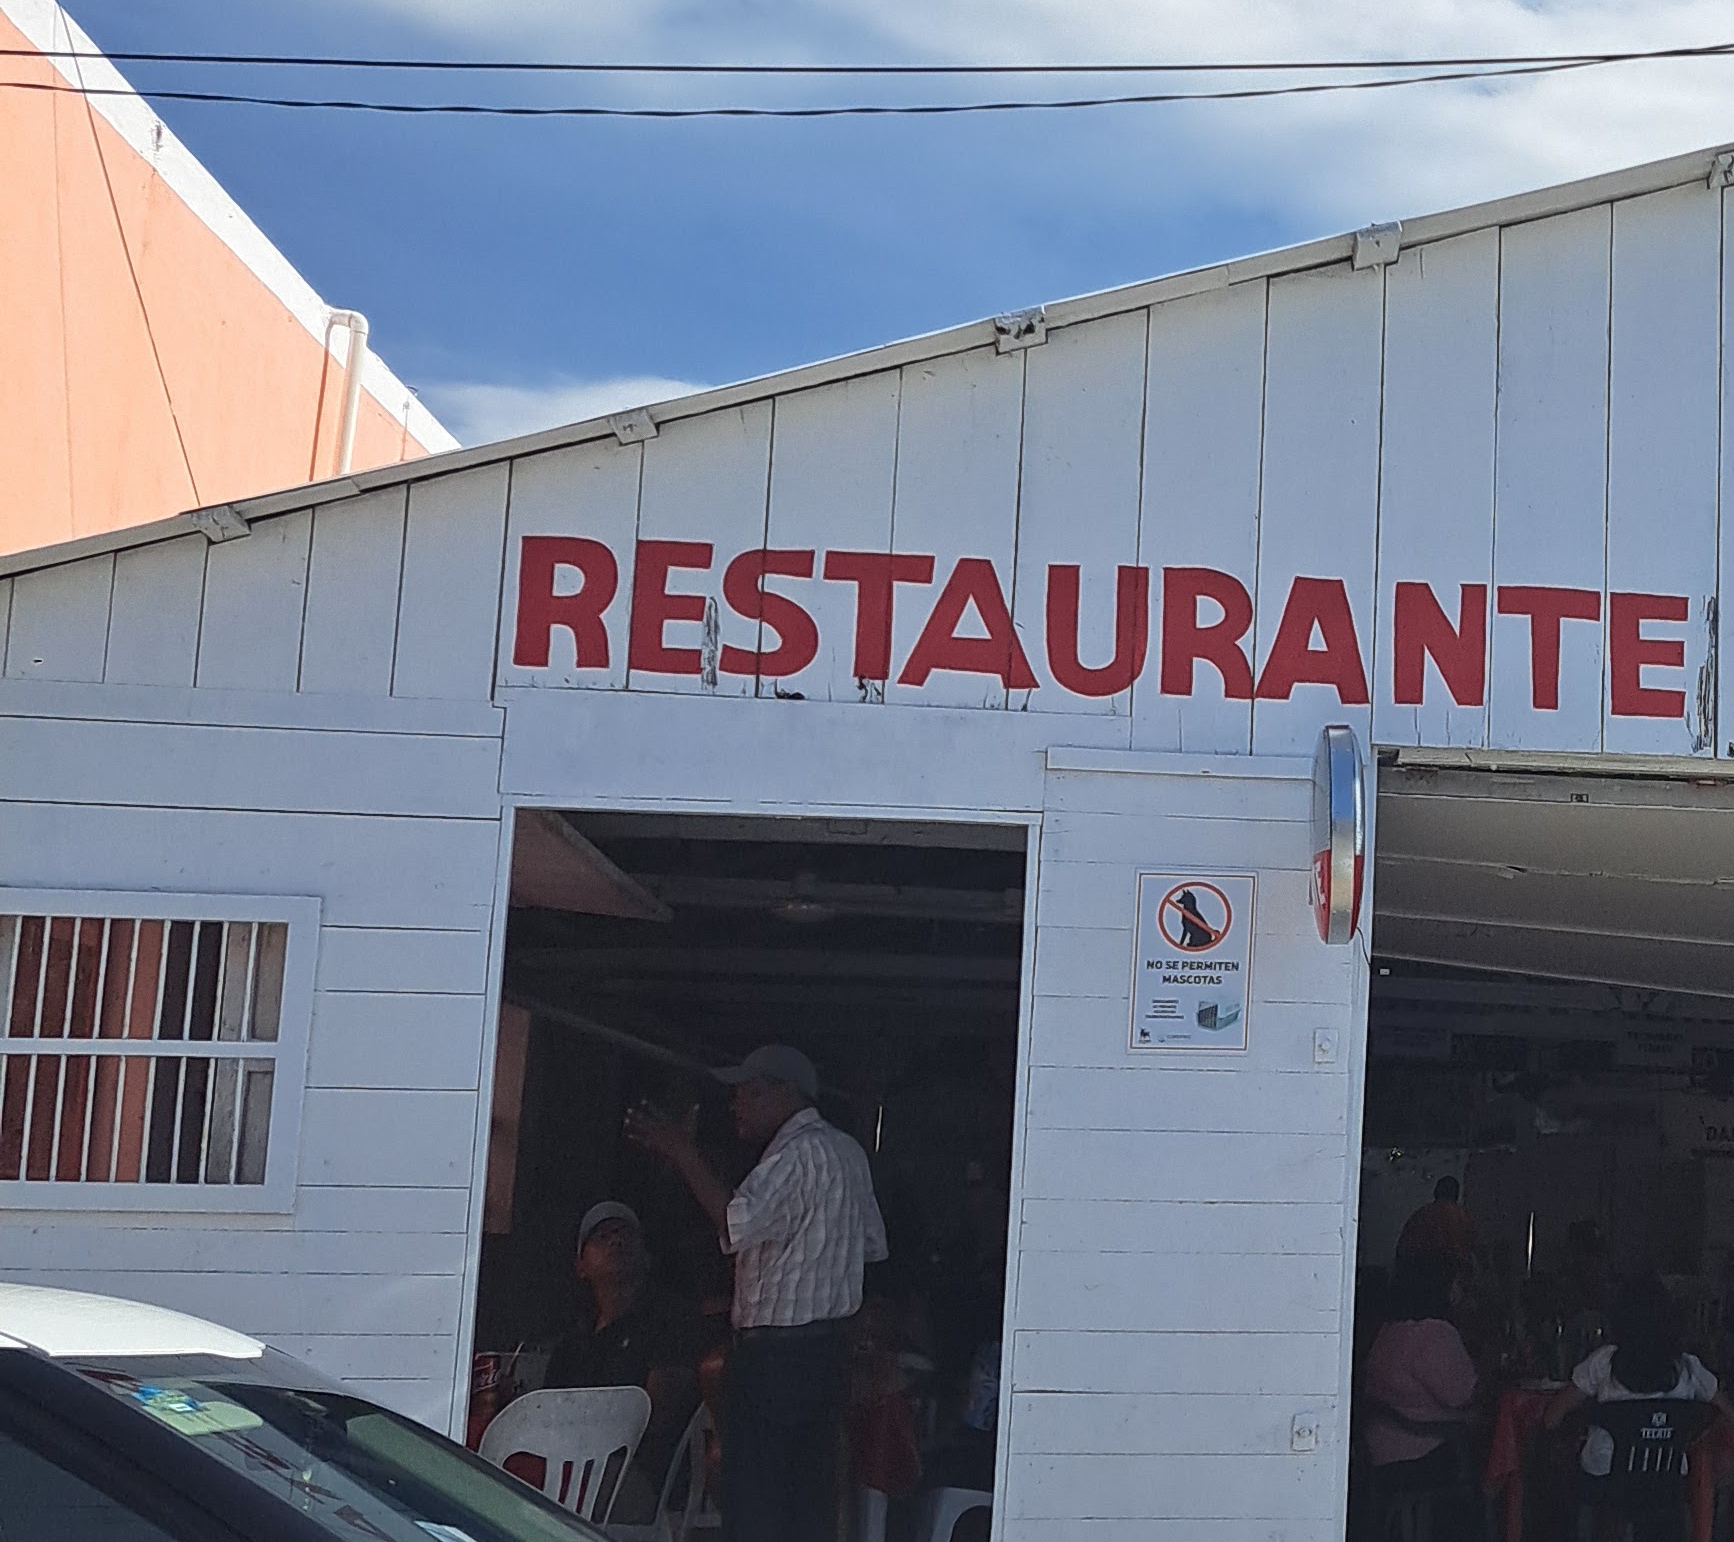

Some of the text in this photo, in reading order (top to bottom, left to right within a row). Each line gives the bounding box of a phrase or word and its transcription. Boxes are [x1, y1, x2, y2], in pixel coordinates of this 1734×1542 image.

[512, 535, 1690, 719] RESTAURANTE
[1146, 960, 1239, 971] NO SE PERMITEN
[1162, 975, 1223, 985] MASCOTAS
